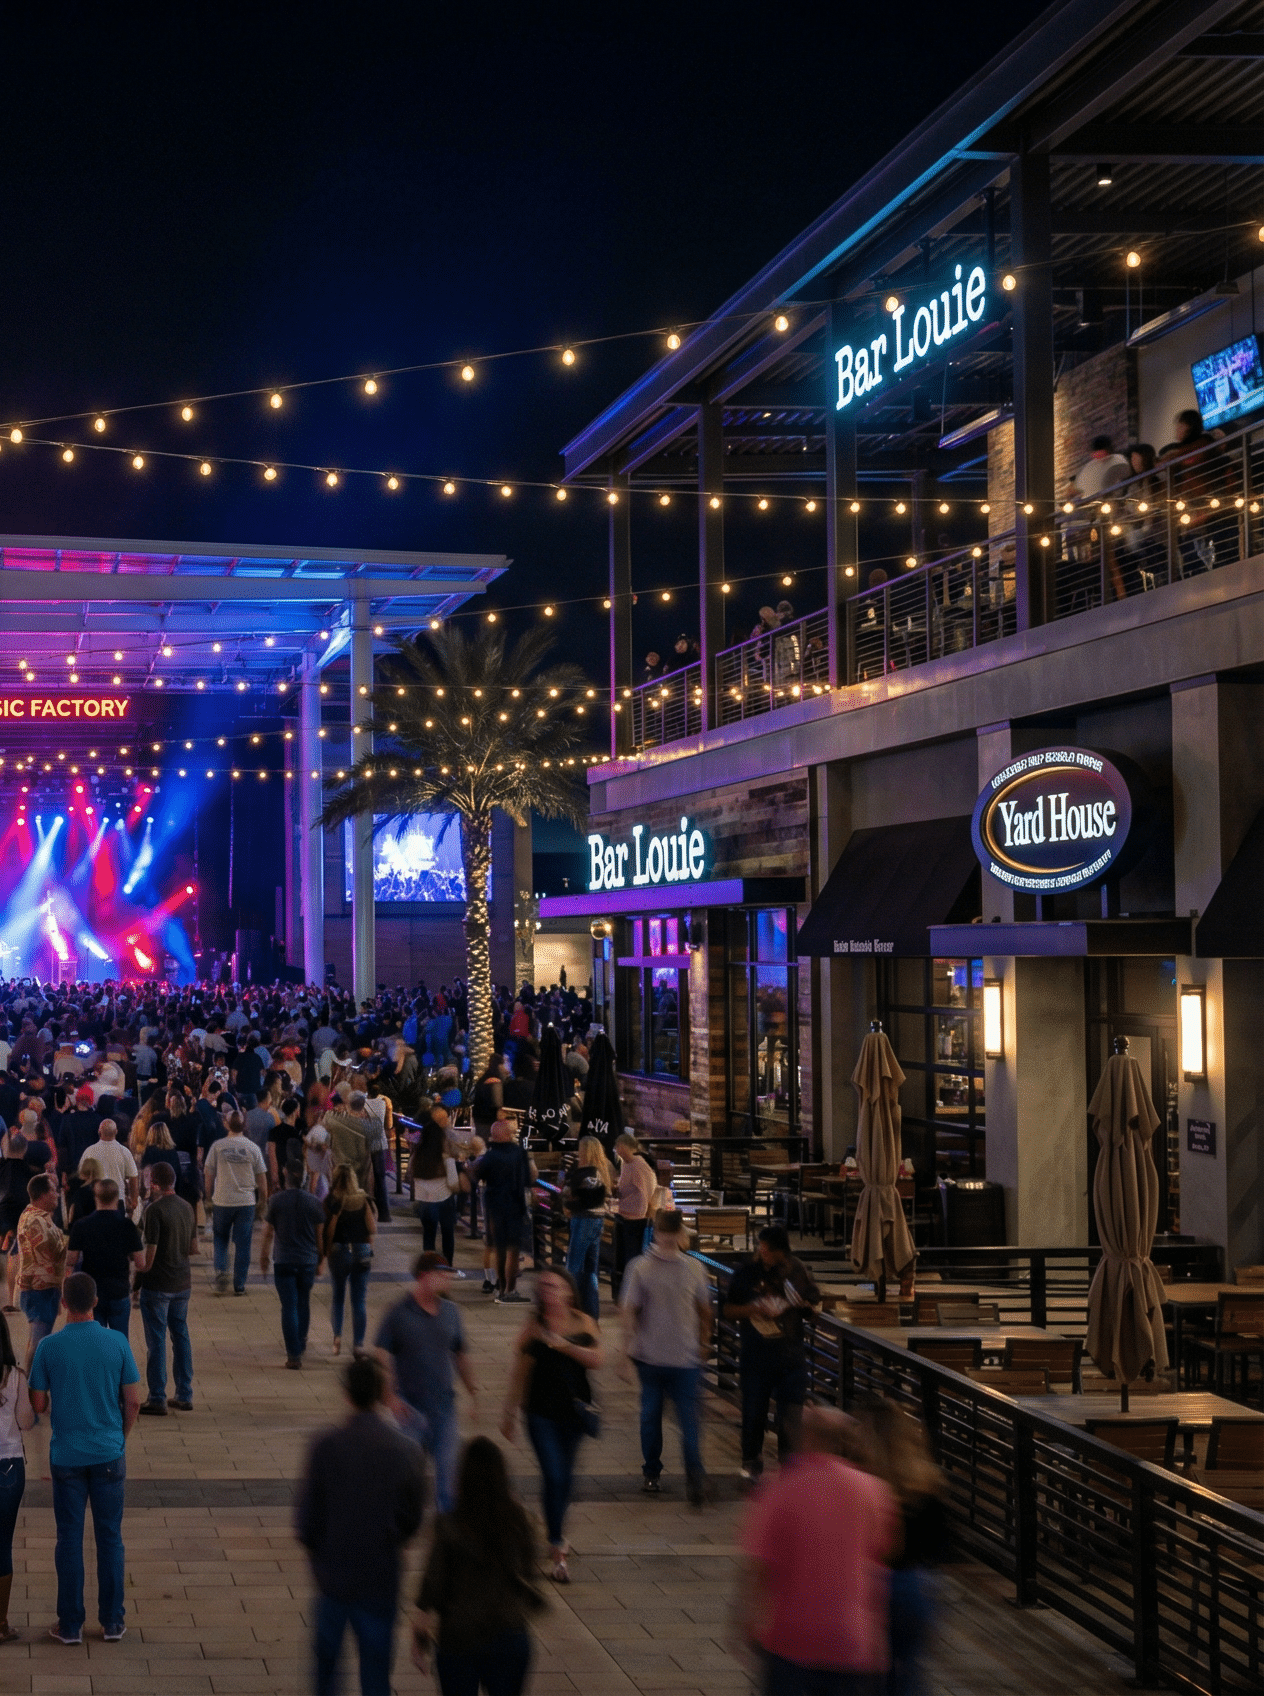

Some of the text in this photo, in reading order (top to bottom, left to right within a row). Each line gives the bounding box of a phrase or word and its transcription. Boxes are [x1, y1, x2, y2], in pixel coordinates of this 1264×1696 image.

[835, 264, 986, 411] Bar Louie
[30, 699, 128, 717] FACTORY
[997, 792, 1117, 847] Yard House
[588, 816, 705, 891] Bar Louie
